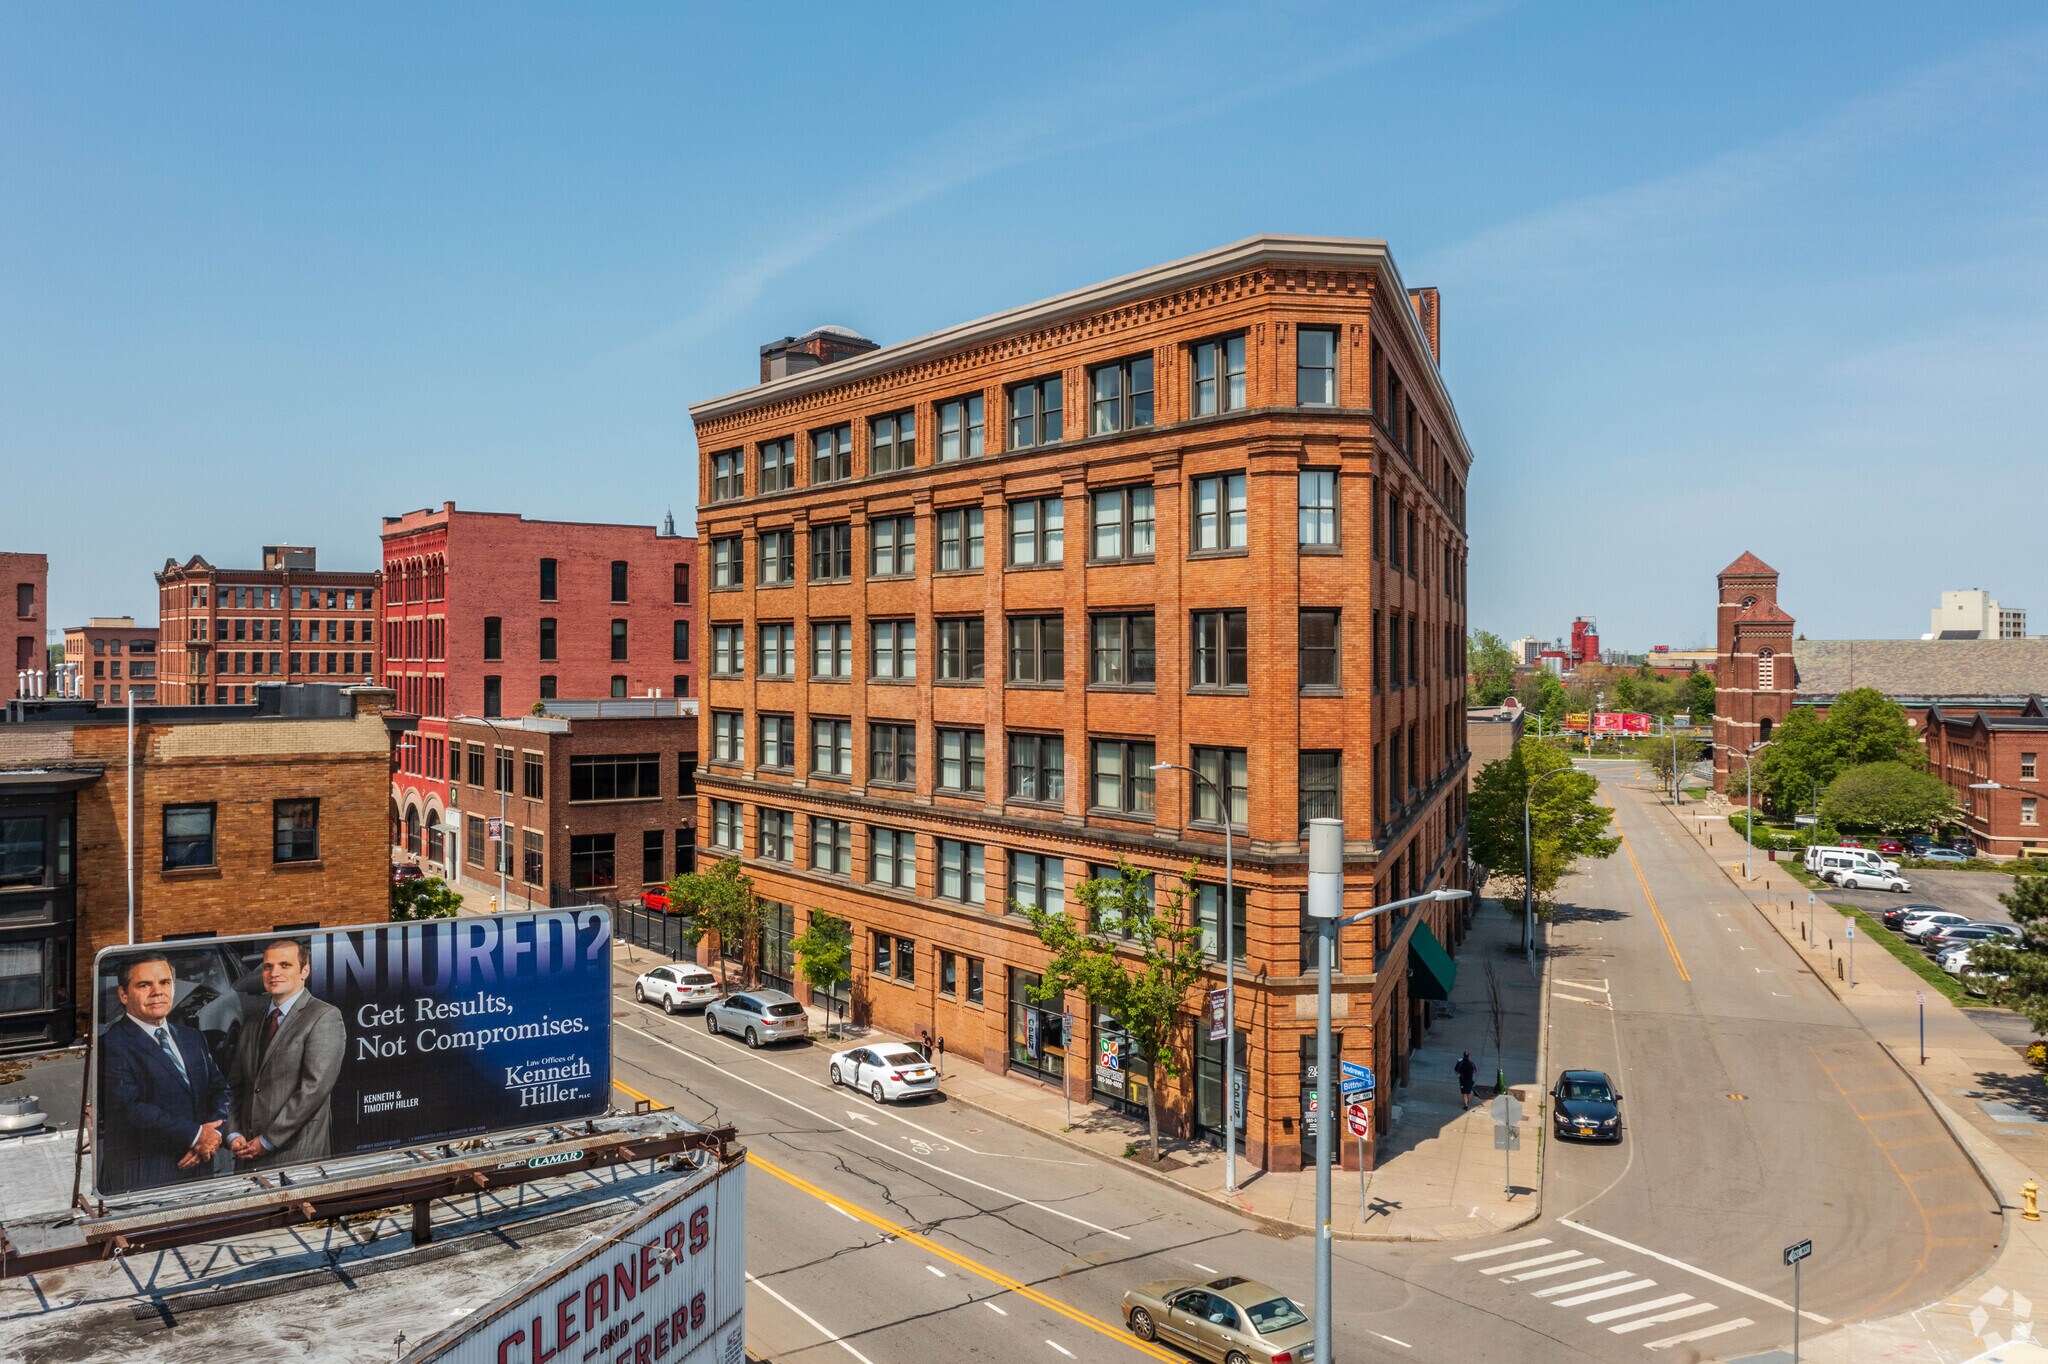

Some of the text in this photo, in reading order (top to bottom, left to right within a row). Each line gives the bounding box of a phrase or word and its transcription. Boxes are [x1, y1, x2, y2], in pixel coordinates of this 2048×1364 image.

[311, 911, 610, 998] INJURED?
[357, 991, 514, 1028] Get Results,
[356, 1015, 590, 1061] Not Compromises.
[541, 1056, 566, 1065] Offices
[567, 1053, 576, 1061] of
[505, 1056, 591, 1087] Kenneth
[1343, 1064, 1364, 1077] Andrews
[1343, 1079, 1366, 1091] Bittner
[363, 1091, 402, 1104] KENNETH &
[520, 1083, 579, 1107] Hiller
[363, 1098, 419, 1114] TIMOTHY HILLER
[1357, 1111, 1365, 1119] NOT
[1352, 1123, 1365, 1132] ENTER
[534, 1152, 578, 1166] LAMAR
[498, 1205, 709, 1364] CLEANERS
[601, 1319, 630, 1354] AND
